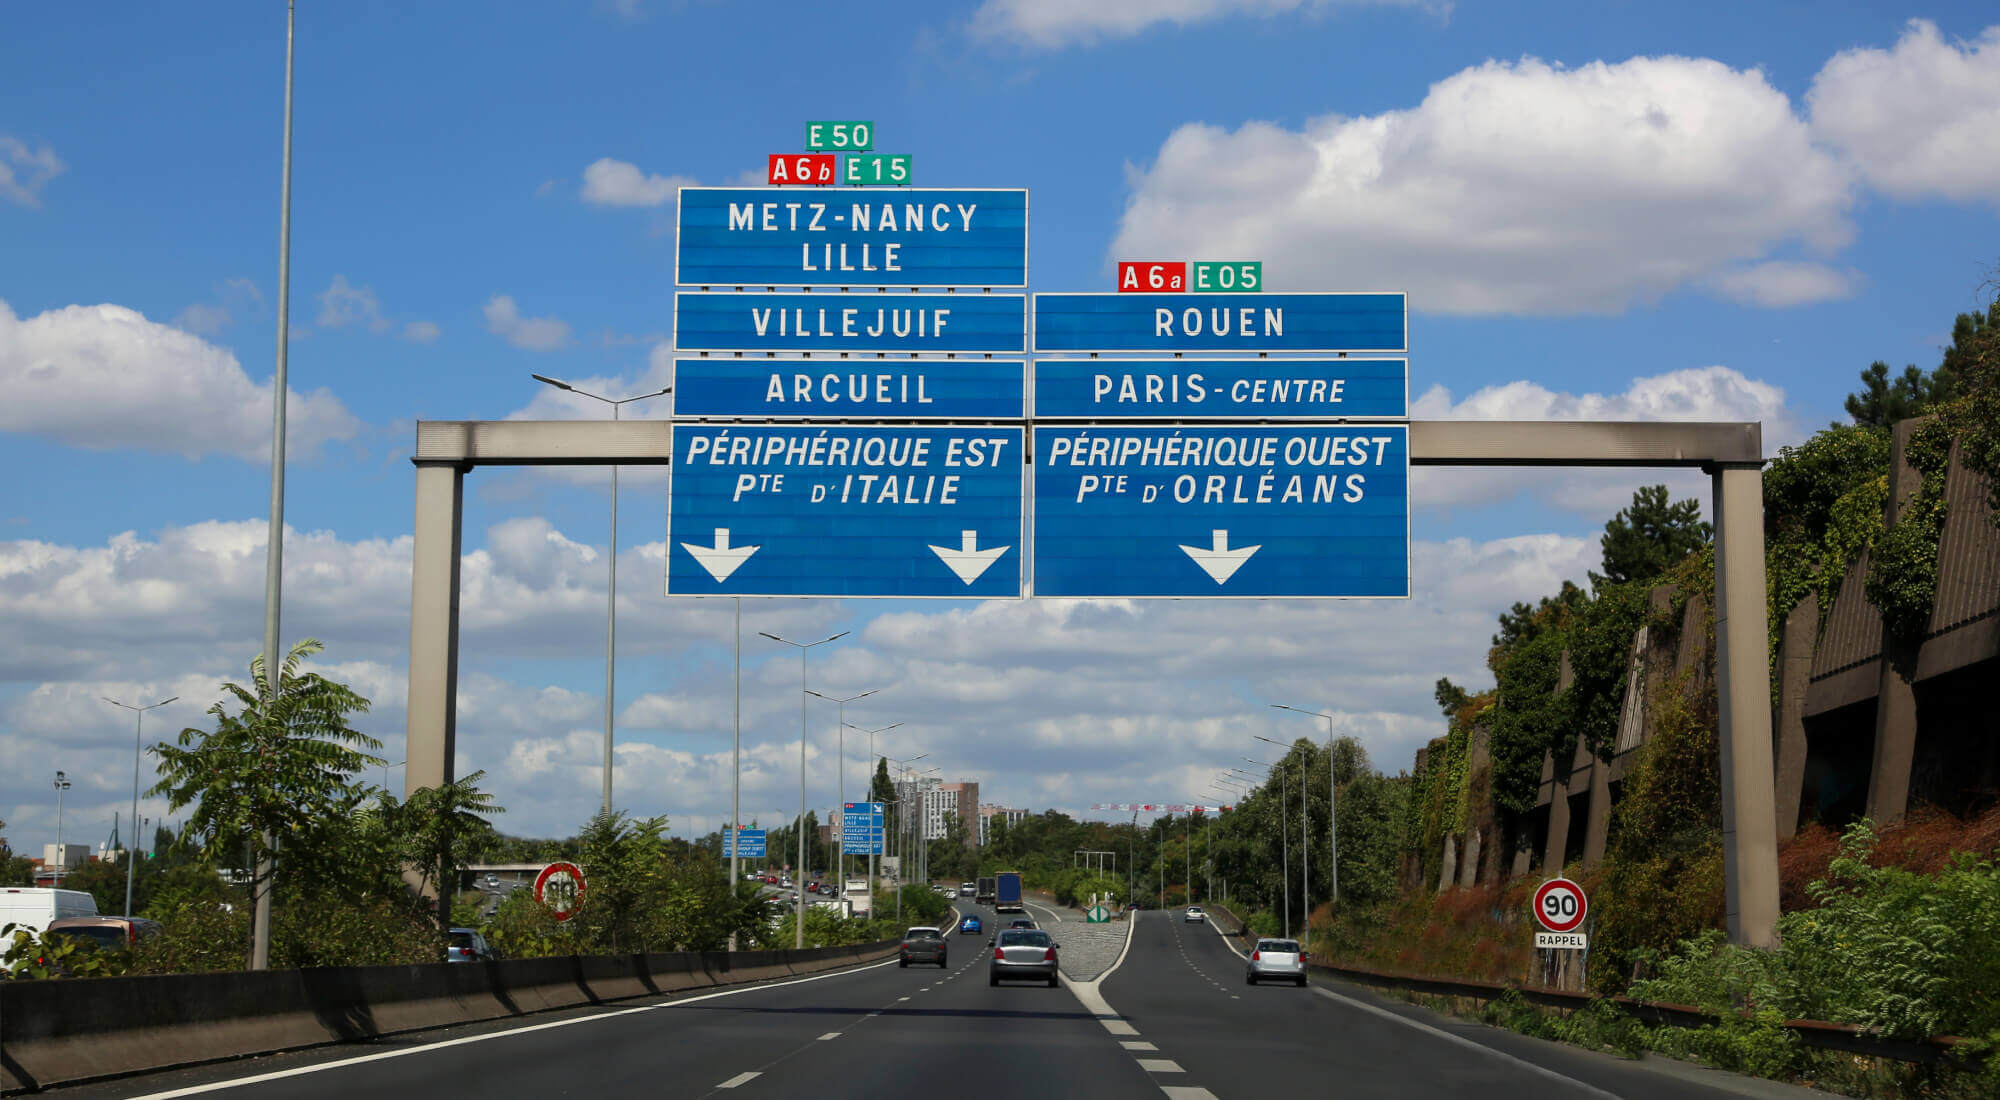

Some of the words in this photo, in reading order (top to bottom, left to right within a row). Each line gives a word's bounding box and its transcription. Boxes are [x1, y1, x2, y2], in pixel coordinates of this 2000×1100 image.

[728, 202, 977, 232] METZ-NANCY
[802, 242, 902, 272] LILLE
[751, 307, 951, 338] VILLEJUIF
[1155, 307, 1283, 337] ROUEN
[765, 373, 933, 403] ARCUEIL
[685, 429, 932, 467] PÉRIPHÉRIQUE
[944, 438, 1009, 467] EST
[1048, 431, 1278, 467] PÉRIPHÉRIQUE
[1283, 435, 1393, 467] OUEST
[1544, 894, 1577, 917] 90
[1539, 935, 1583, 946] RAPPEL
